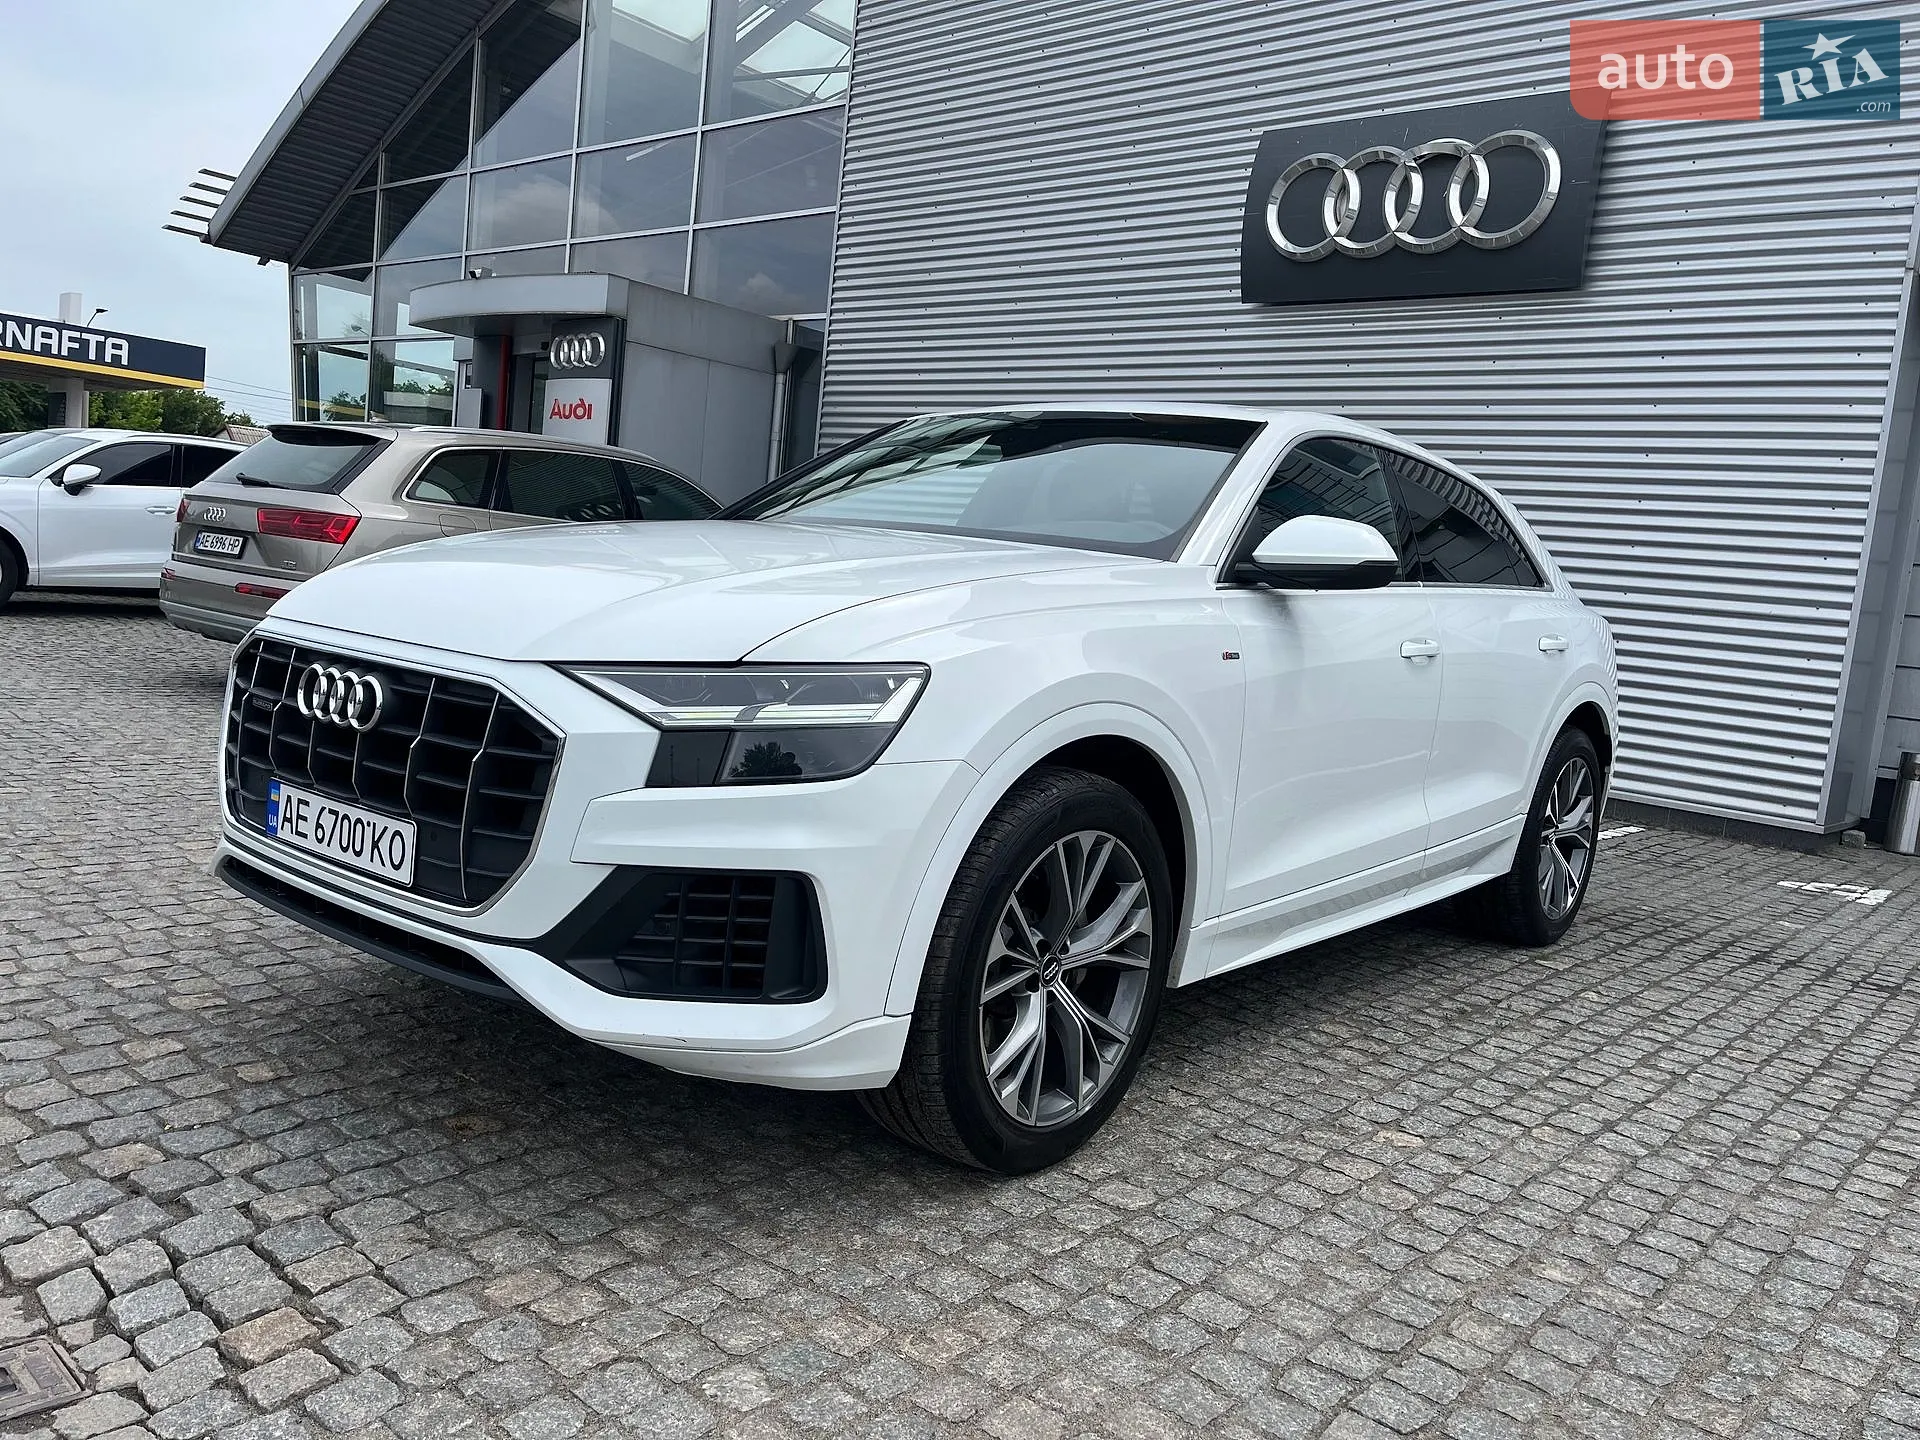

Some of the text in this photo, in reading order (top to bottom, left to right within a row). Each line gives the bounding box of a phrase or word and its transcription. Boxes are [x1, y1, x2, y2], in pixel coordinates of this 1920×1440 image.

[0, 320, 129, 366] NAFTA
[549, 398, 593, 420] Audi
[200, 534, 240, 551] AE 6996 HP
[268, 814, 277, 827] UA
[280, 794, 406, 871] AE 6700 KO
